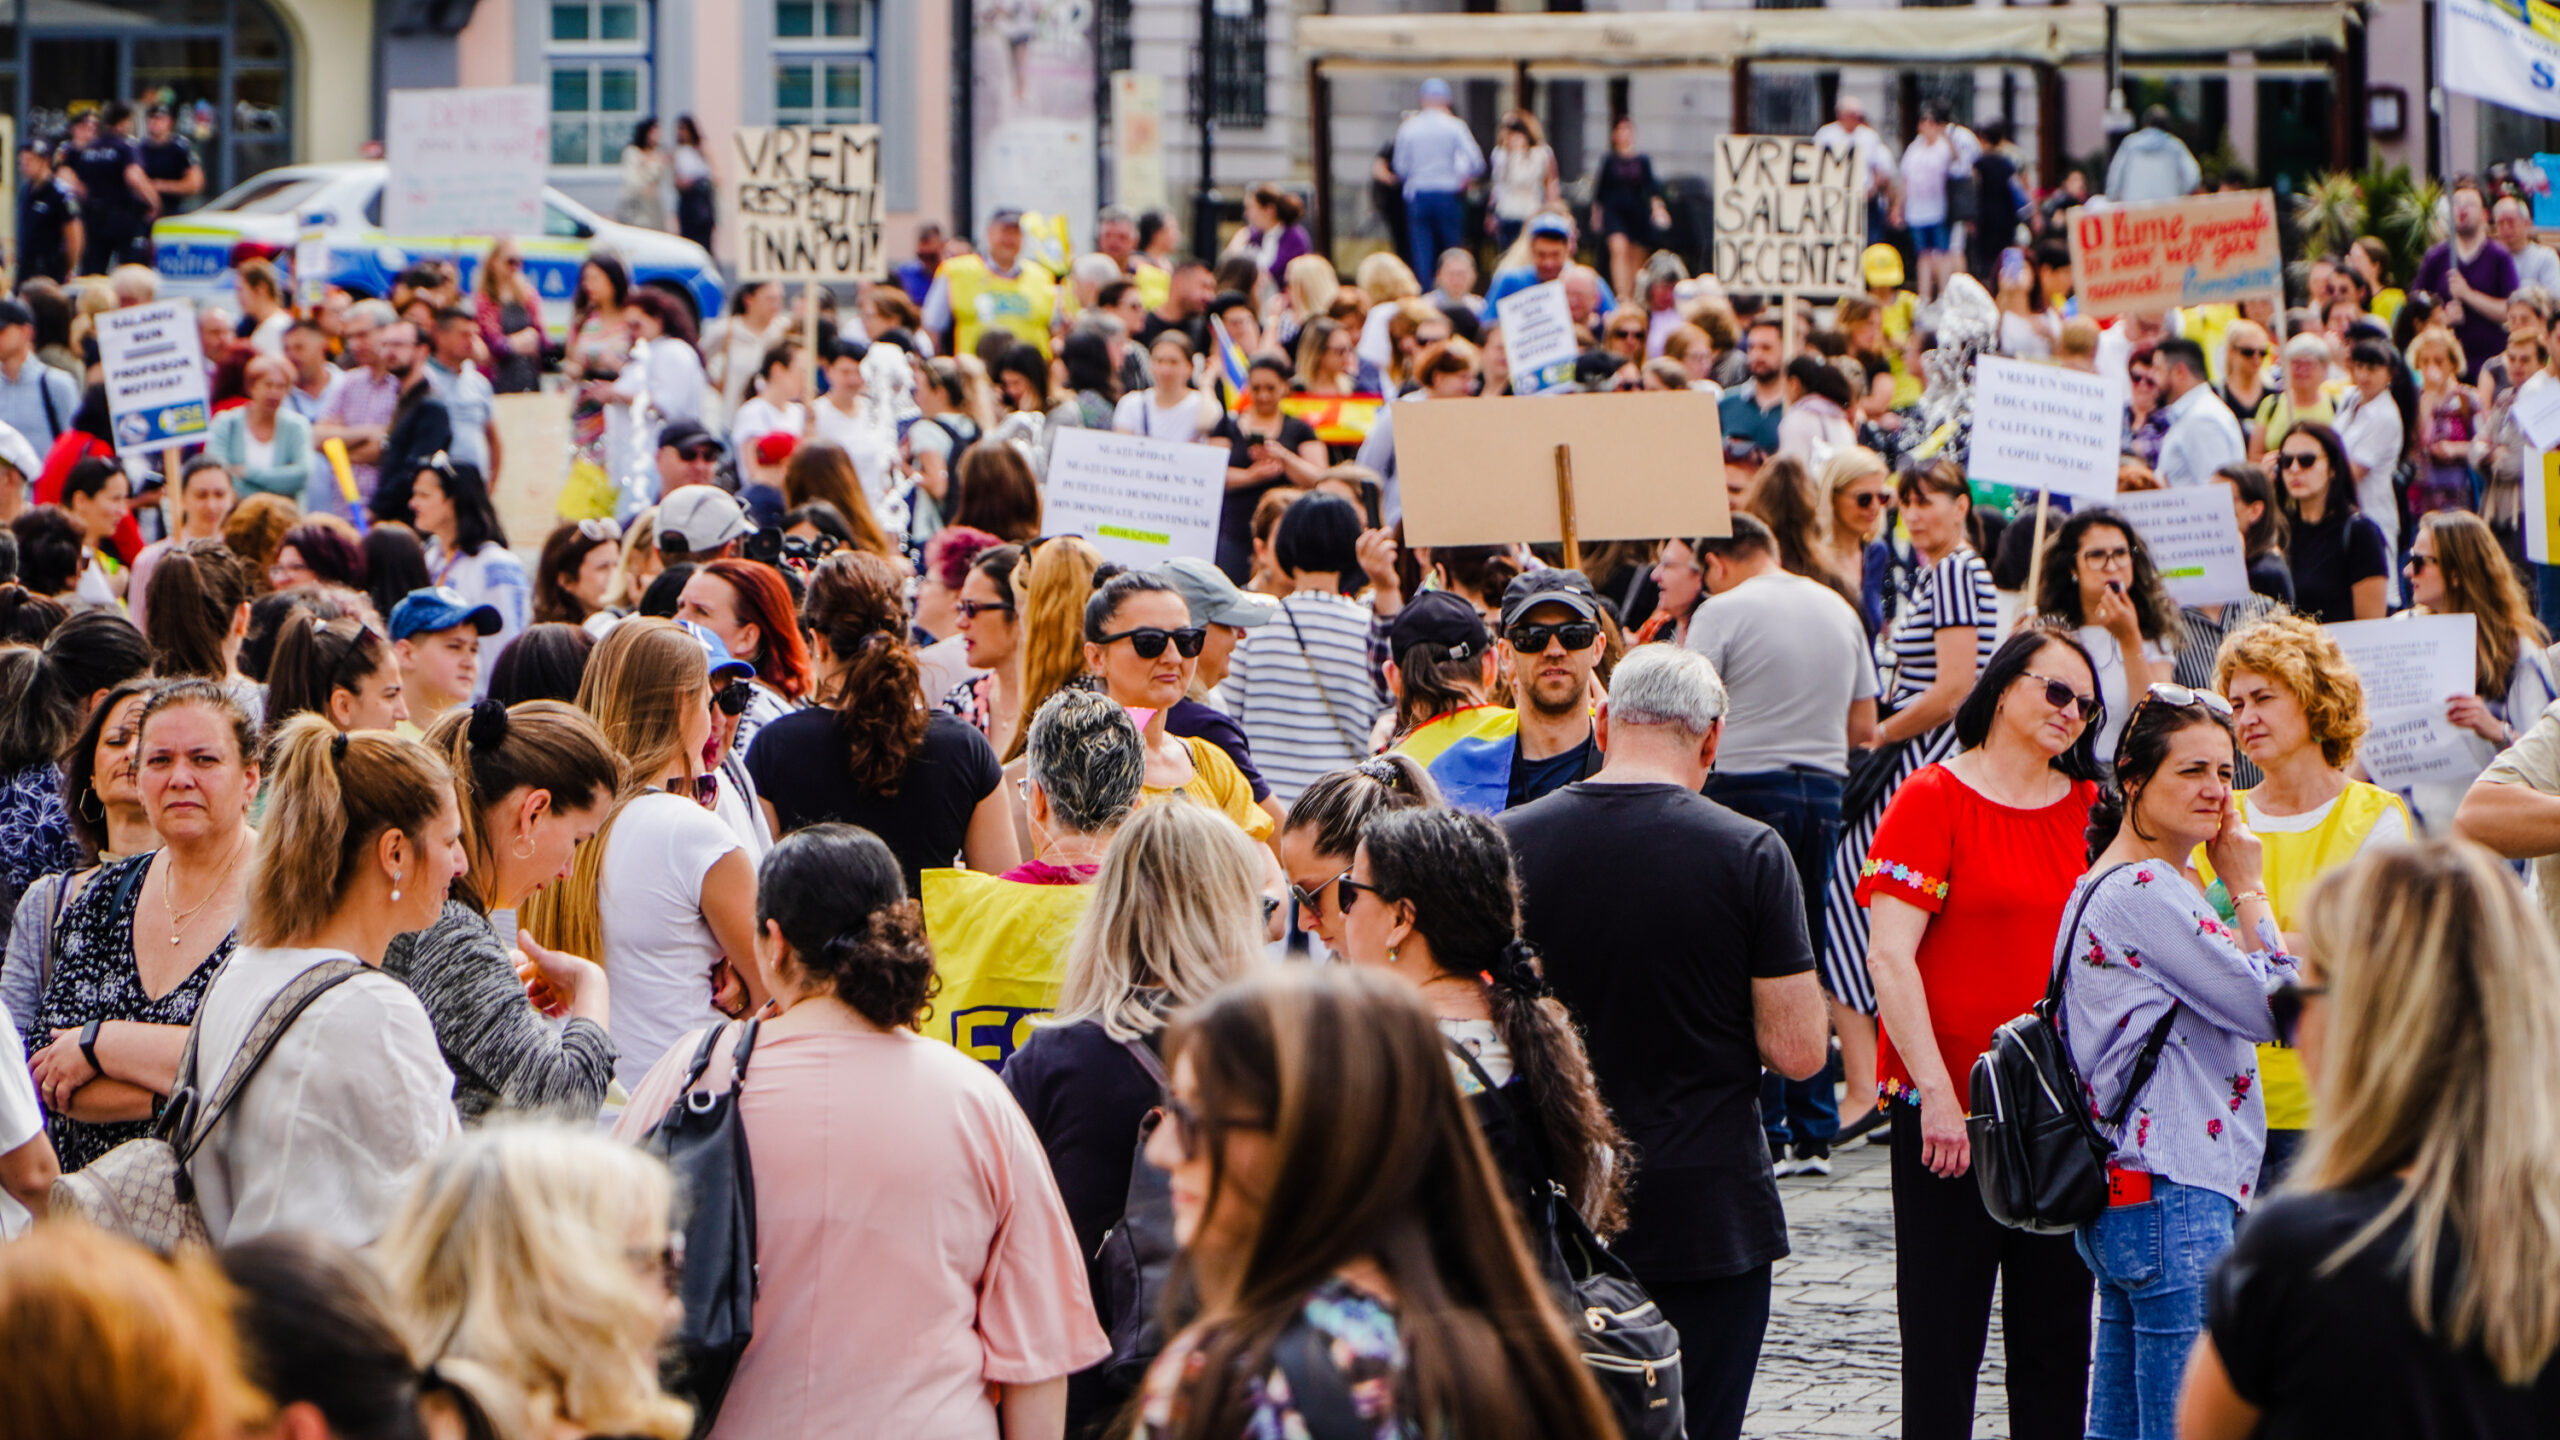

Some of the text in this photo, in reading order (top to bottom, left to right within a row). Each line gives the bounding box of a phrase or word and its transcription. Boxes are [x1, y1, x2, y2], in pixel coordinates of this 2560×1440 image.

[733, 127, 880, 184] VREM
[1720, 137, 1857, 187] VREM
[2079, 213, 2103, 250] O
[112, 356, 191, 380] PROFESOR
[119, 375, 184, 397] MOTIVAT
[1998, 369, 2105, 399] VREM UN SISTEM
[2089, 411, 2105, 424] DE
[1988, 418, 2104, 449] CALITATE PENTRU
